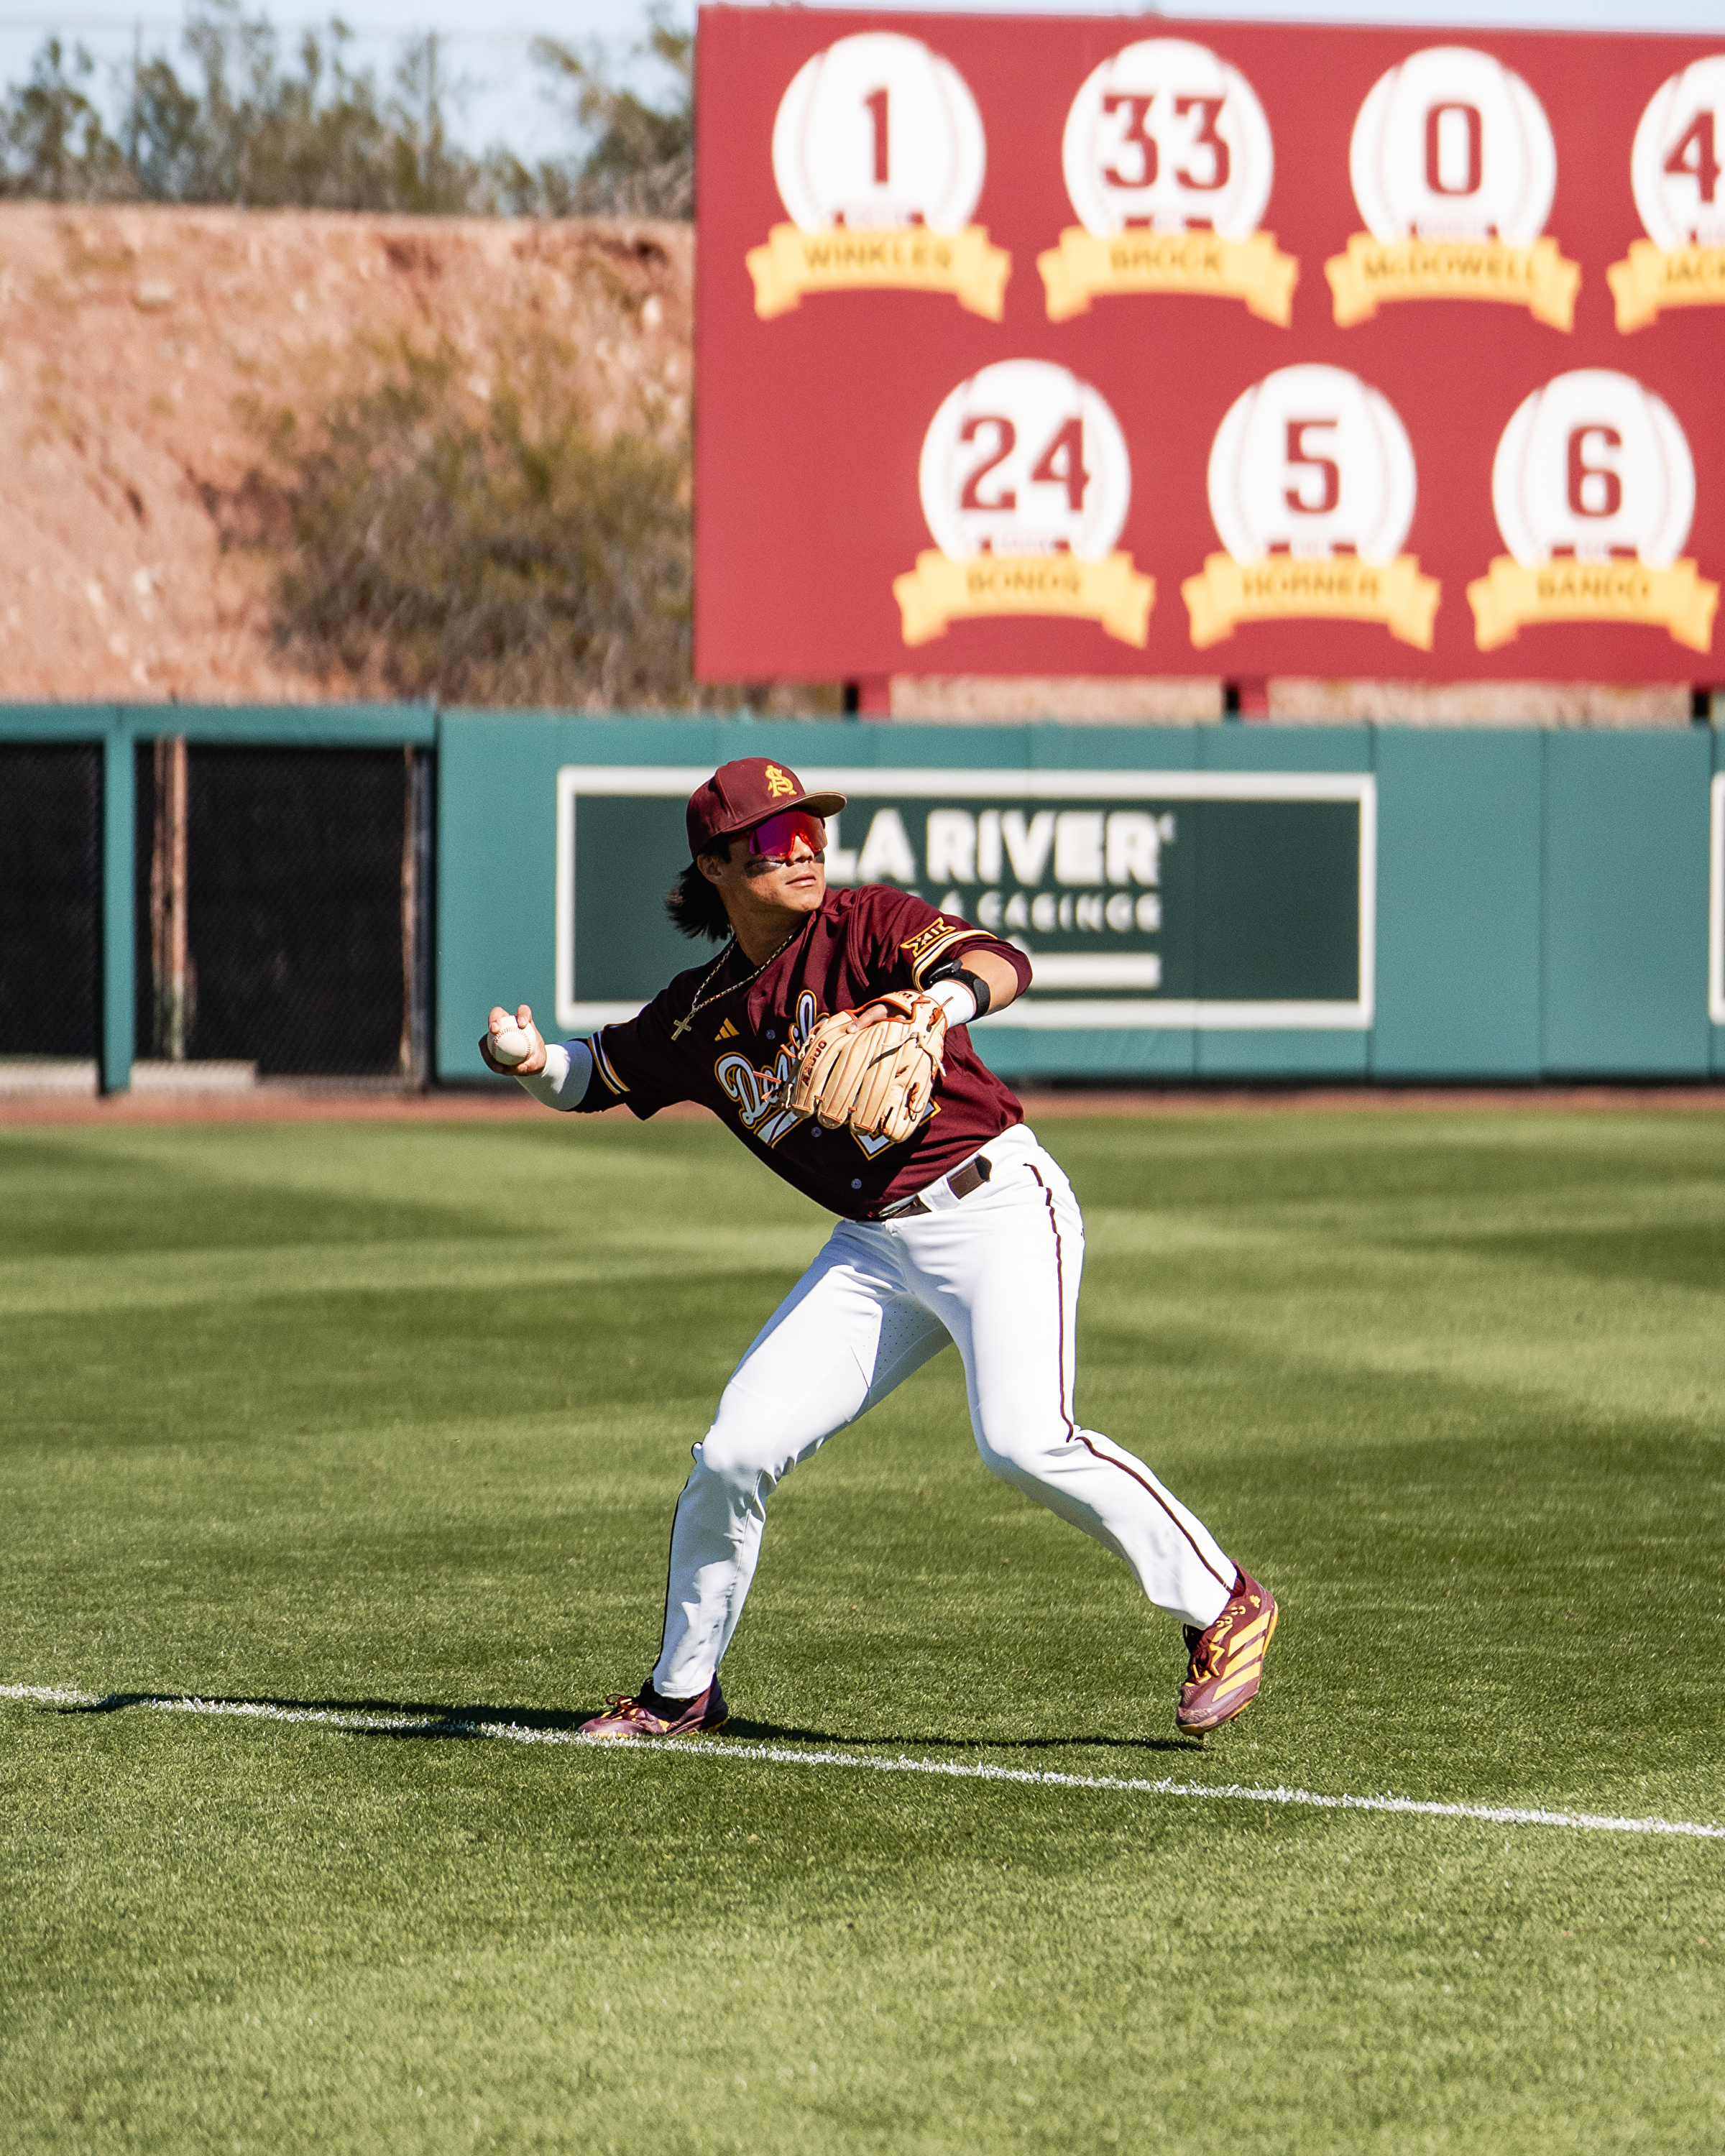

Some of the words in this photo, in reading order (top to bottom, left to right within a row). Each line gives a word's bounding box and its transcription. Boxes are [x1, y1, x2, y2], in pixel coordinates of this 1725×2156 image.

[864, 86, 889, 183] 1
[1103, 94, 1230, 190] 33
[1425, 102, 1482, 195] 0
[803, 241, 953, 271] WINKLES
[960, 416, 1090, 512] 24
[1285, 420, 1340, 515] 5
[1567, 425, 1622, 517] 6
[824, 808, 916, 885] LA
